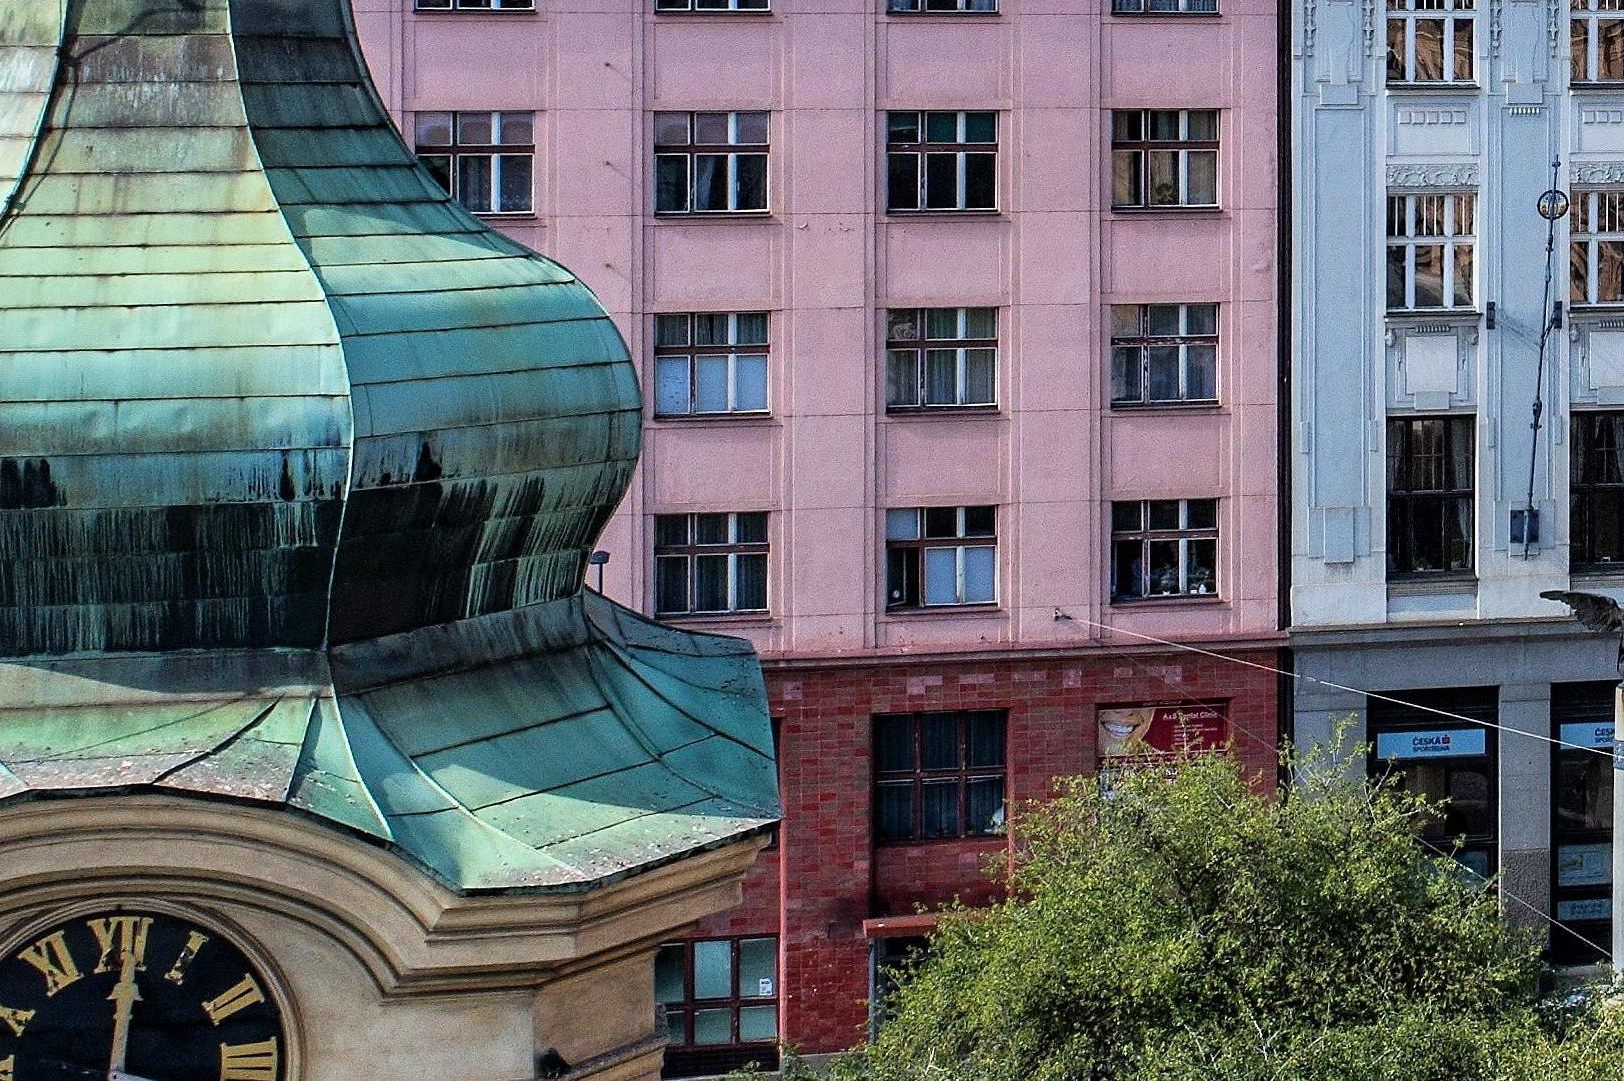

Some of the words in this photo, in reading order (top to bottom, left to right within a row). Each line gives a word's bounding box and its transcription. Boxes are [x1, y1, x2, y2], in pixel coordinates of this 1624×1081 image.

[1412, 736, 1441, 746] ČESKÁ
[17, 930, 84, 997] XI
[202, 973, 265, 1026] II
